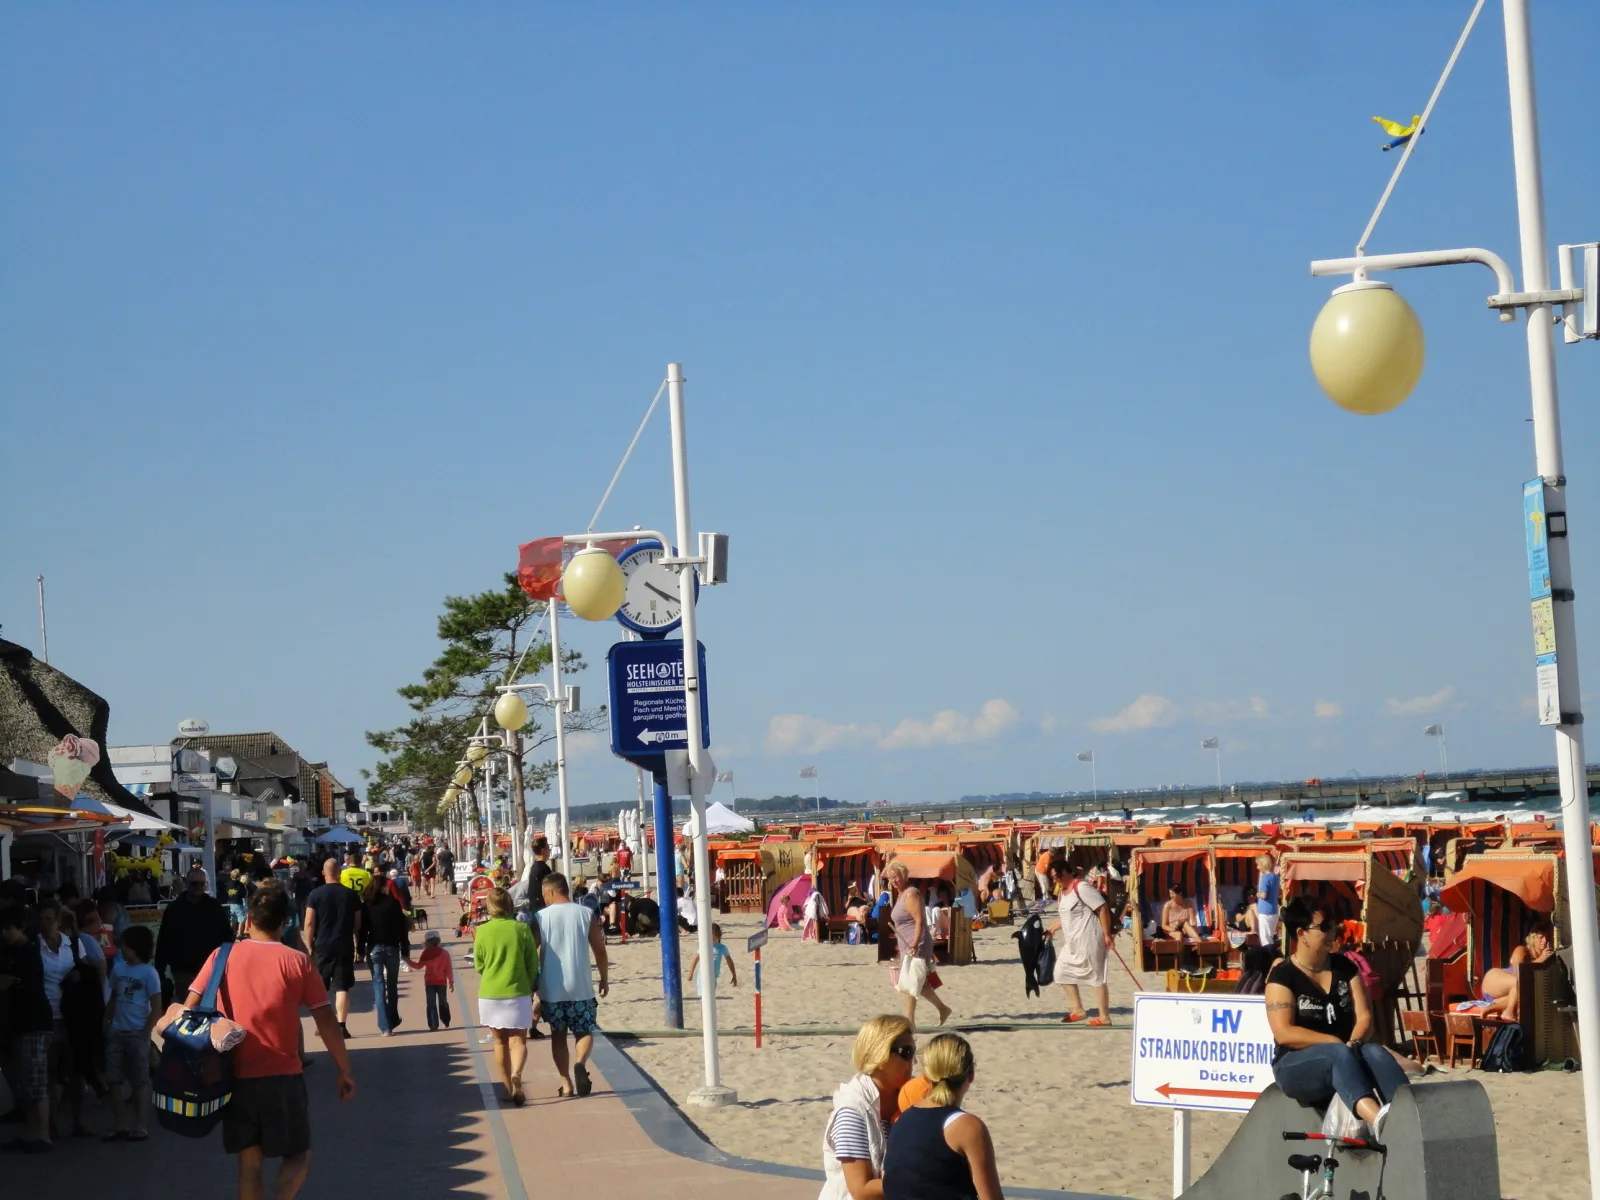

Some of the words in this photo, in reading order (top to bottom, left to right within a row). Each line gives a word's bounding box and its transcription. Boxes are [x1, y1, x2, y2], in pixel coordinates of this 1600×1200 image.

[626, 662, 683, 680] SEEHOTE
[627, 679, 676, 687] HOLSTEINISCHER
[633, 699, 664, 707] Regionale
[633, 706, 650, 714] Fisch
[633, 714, 663, 722] ganzjährig
[665, 712, 686, 720] geöffne
[1211, 1008, 1243, 1034] HV
[1139, 1037, 1275, 1065] STRANDKORBVERMI
[1199, 1069, 1255, 1084] Dücker
